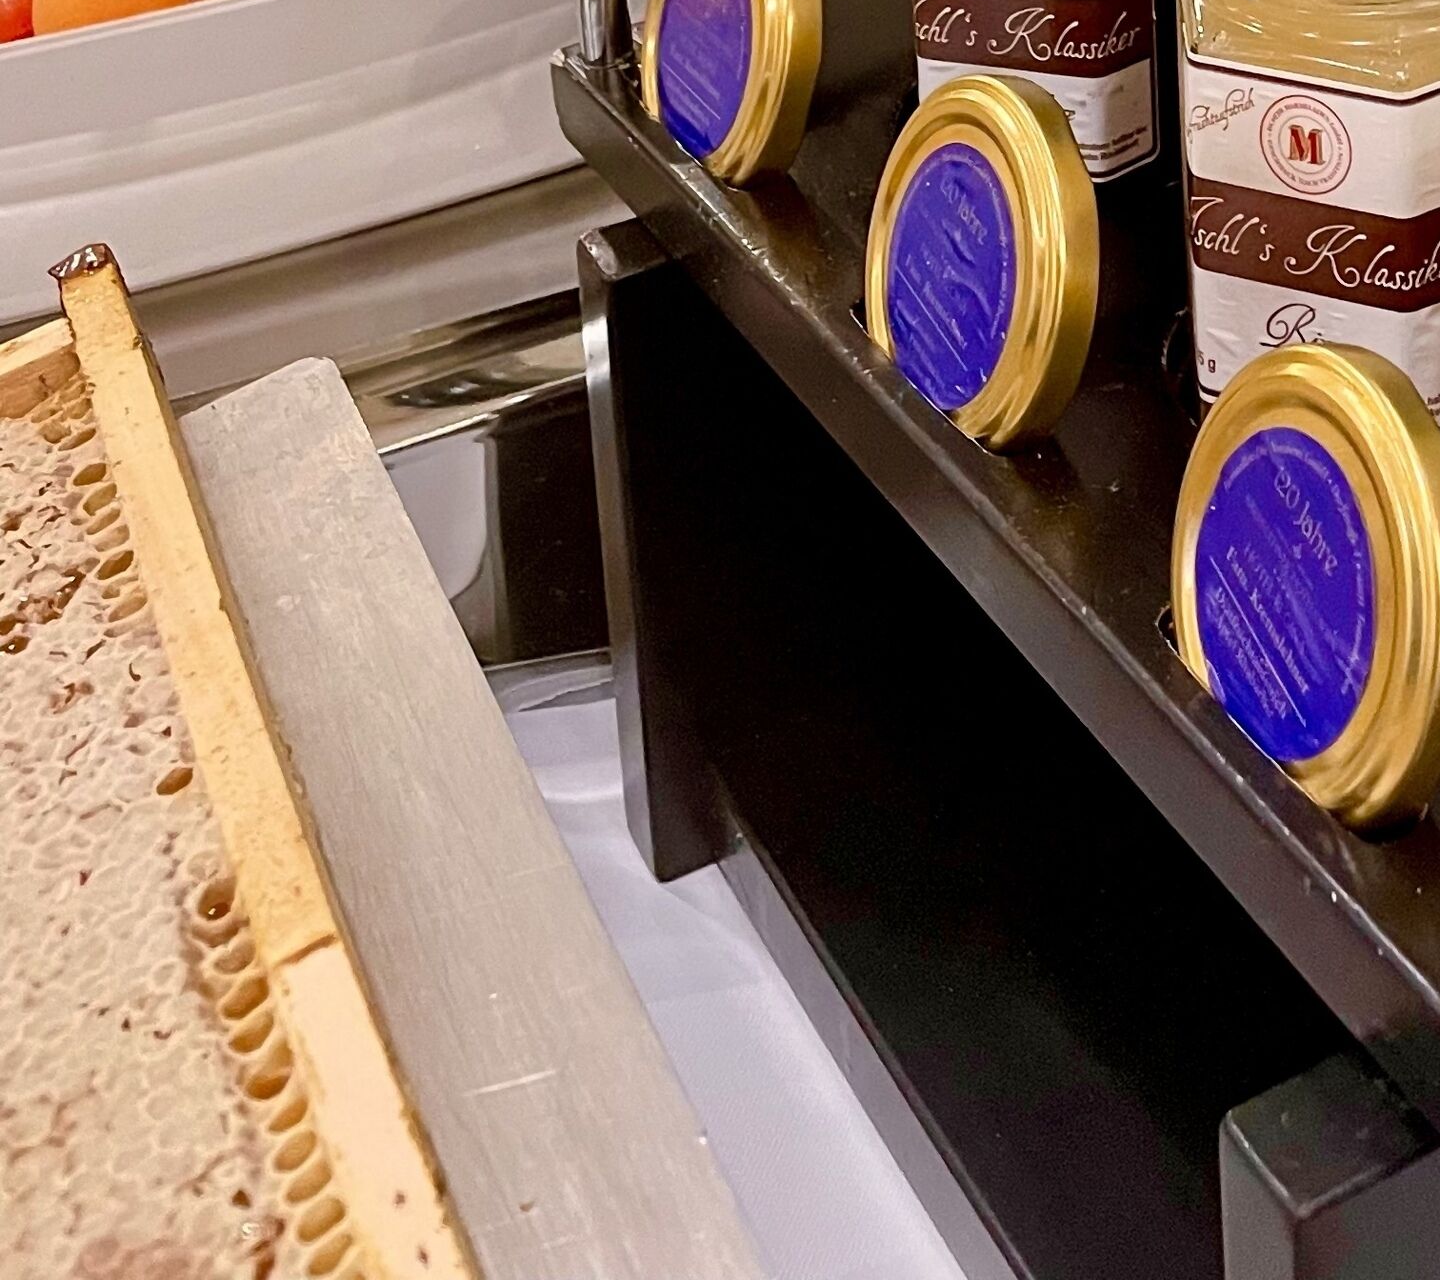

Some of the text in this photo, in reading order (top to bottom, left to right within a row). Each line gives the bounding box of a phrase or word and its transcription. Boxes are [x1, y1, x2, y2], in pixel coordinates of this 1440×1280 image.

[986, 6, 1142, 62] Klassiker
[1287, 124, 1326, 166] M
[1293, 500, 1339, 577] Jahre
